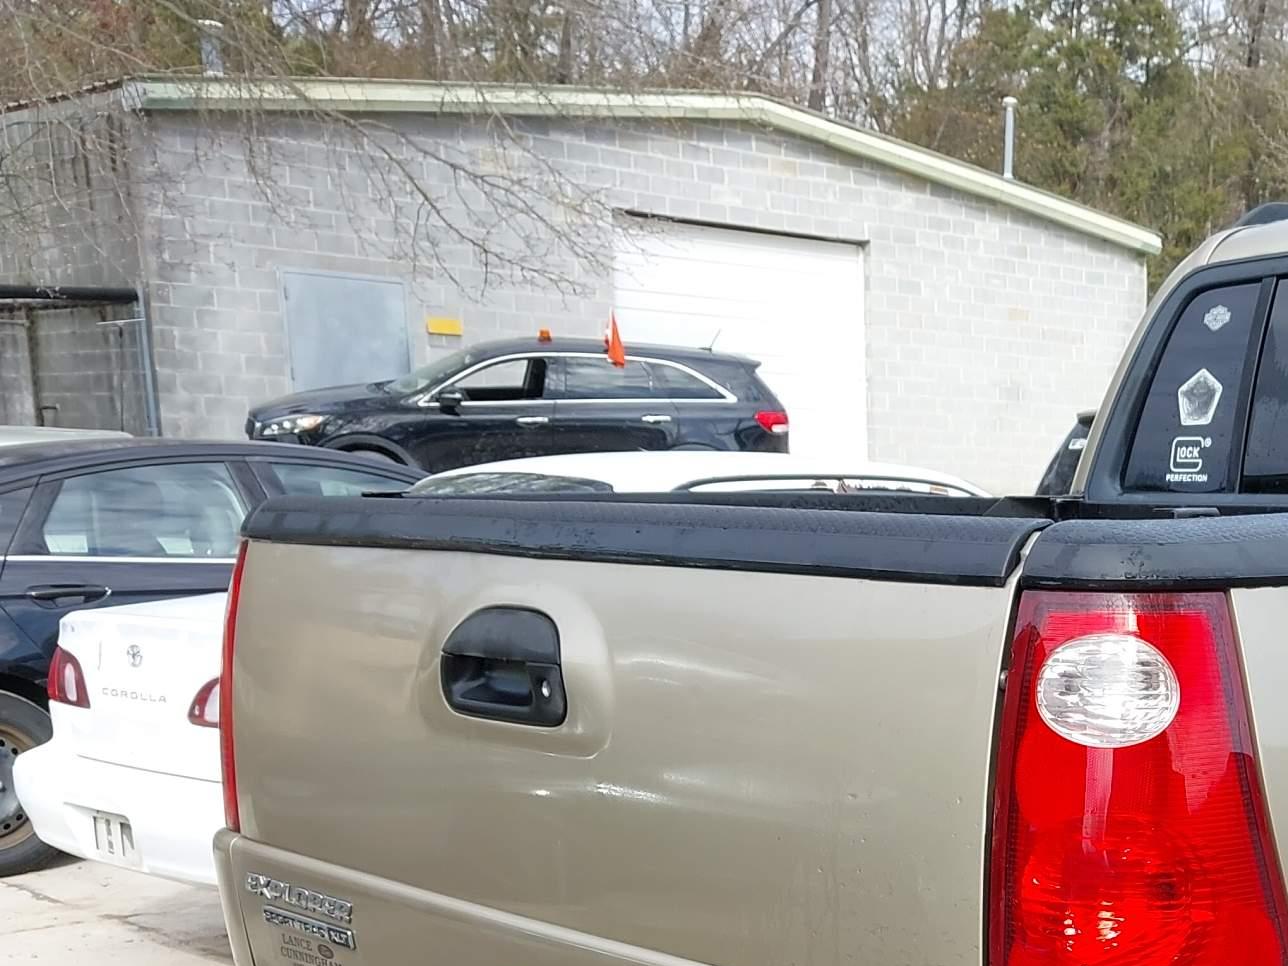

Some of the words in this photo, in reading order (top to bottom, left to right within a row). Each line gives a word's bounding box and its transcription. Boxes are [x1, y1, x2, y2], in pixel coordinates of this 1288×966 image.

[1165, 474, 1208, 482] PERFECTION
[102, 687, 167, 703] COROLLA
[281, 933, 312, 951] LANCE
